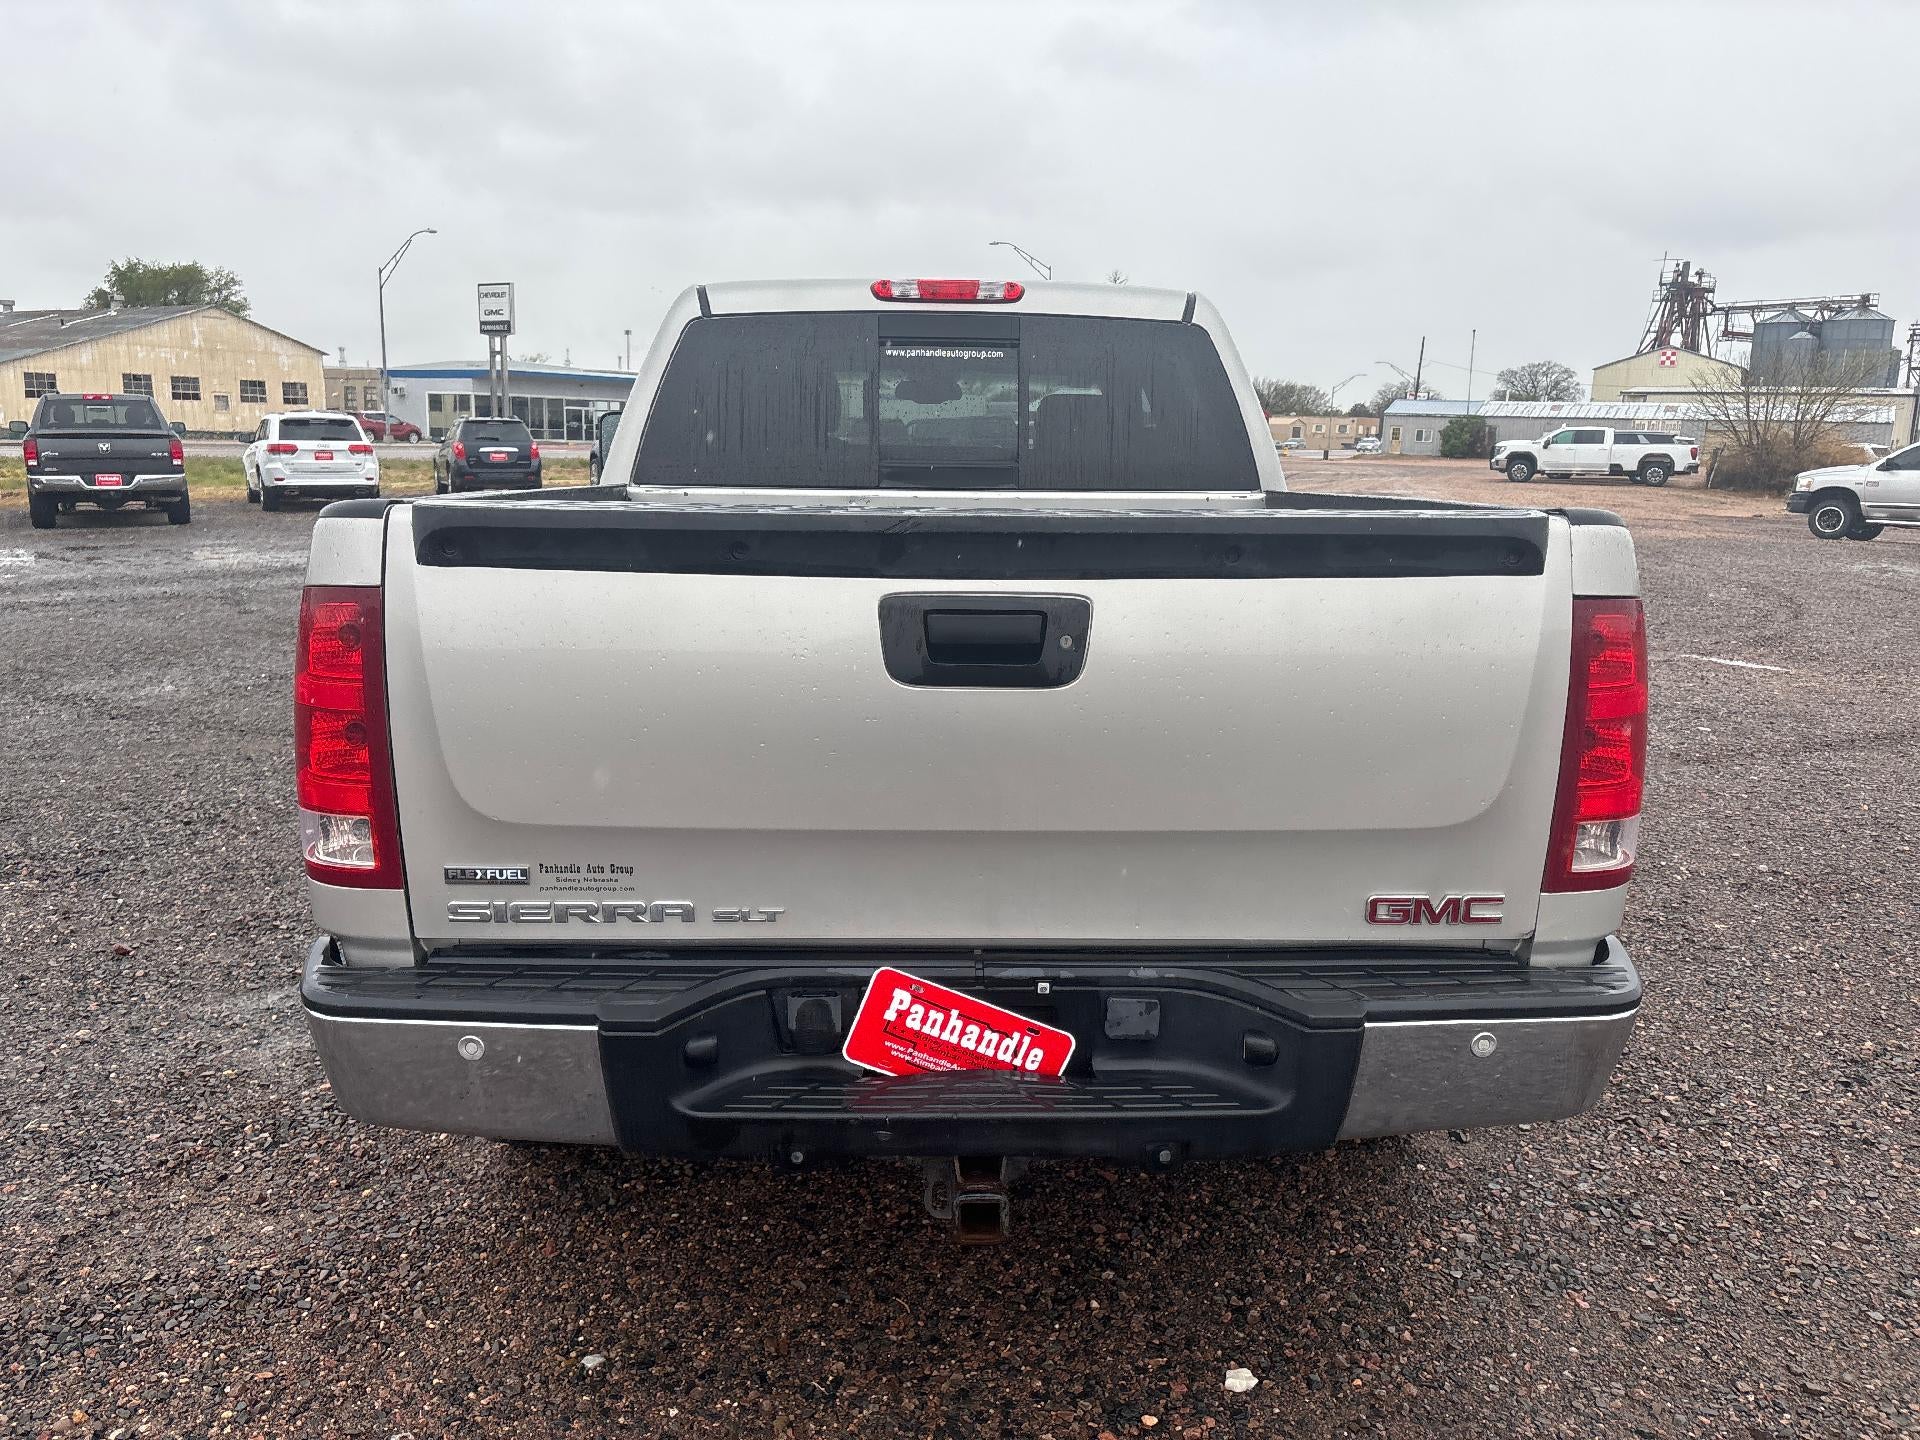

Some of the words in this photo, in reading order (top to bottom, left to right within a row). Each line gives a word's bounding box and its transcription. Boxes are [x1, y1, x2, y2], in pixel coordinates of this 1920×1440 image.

[885, 348, 1004, 360] www.panhandleautogroup.com
[447, 869, 527, 880] FLEXFUEL
[539, 863, 581, 874] Panhandle
[586, 863, 605, 874] Auto
[610, 863, 634, 877] Group
[539, 885, 636, 893] panhandleautogroup.com
[447, 900, 696, 923] SIERRA
[712, 907, 785, 923] SLT
[1366, 893, 1505, 925] GMC
[883, 987, 1044, 1072] Panhandle
